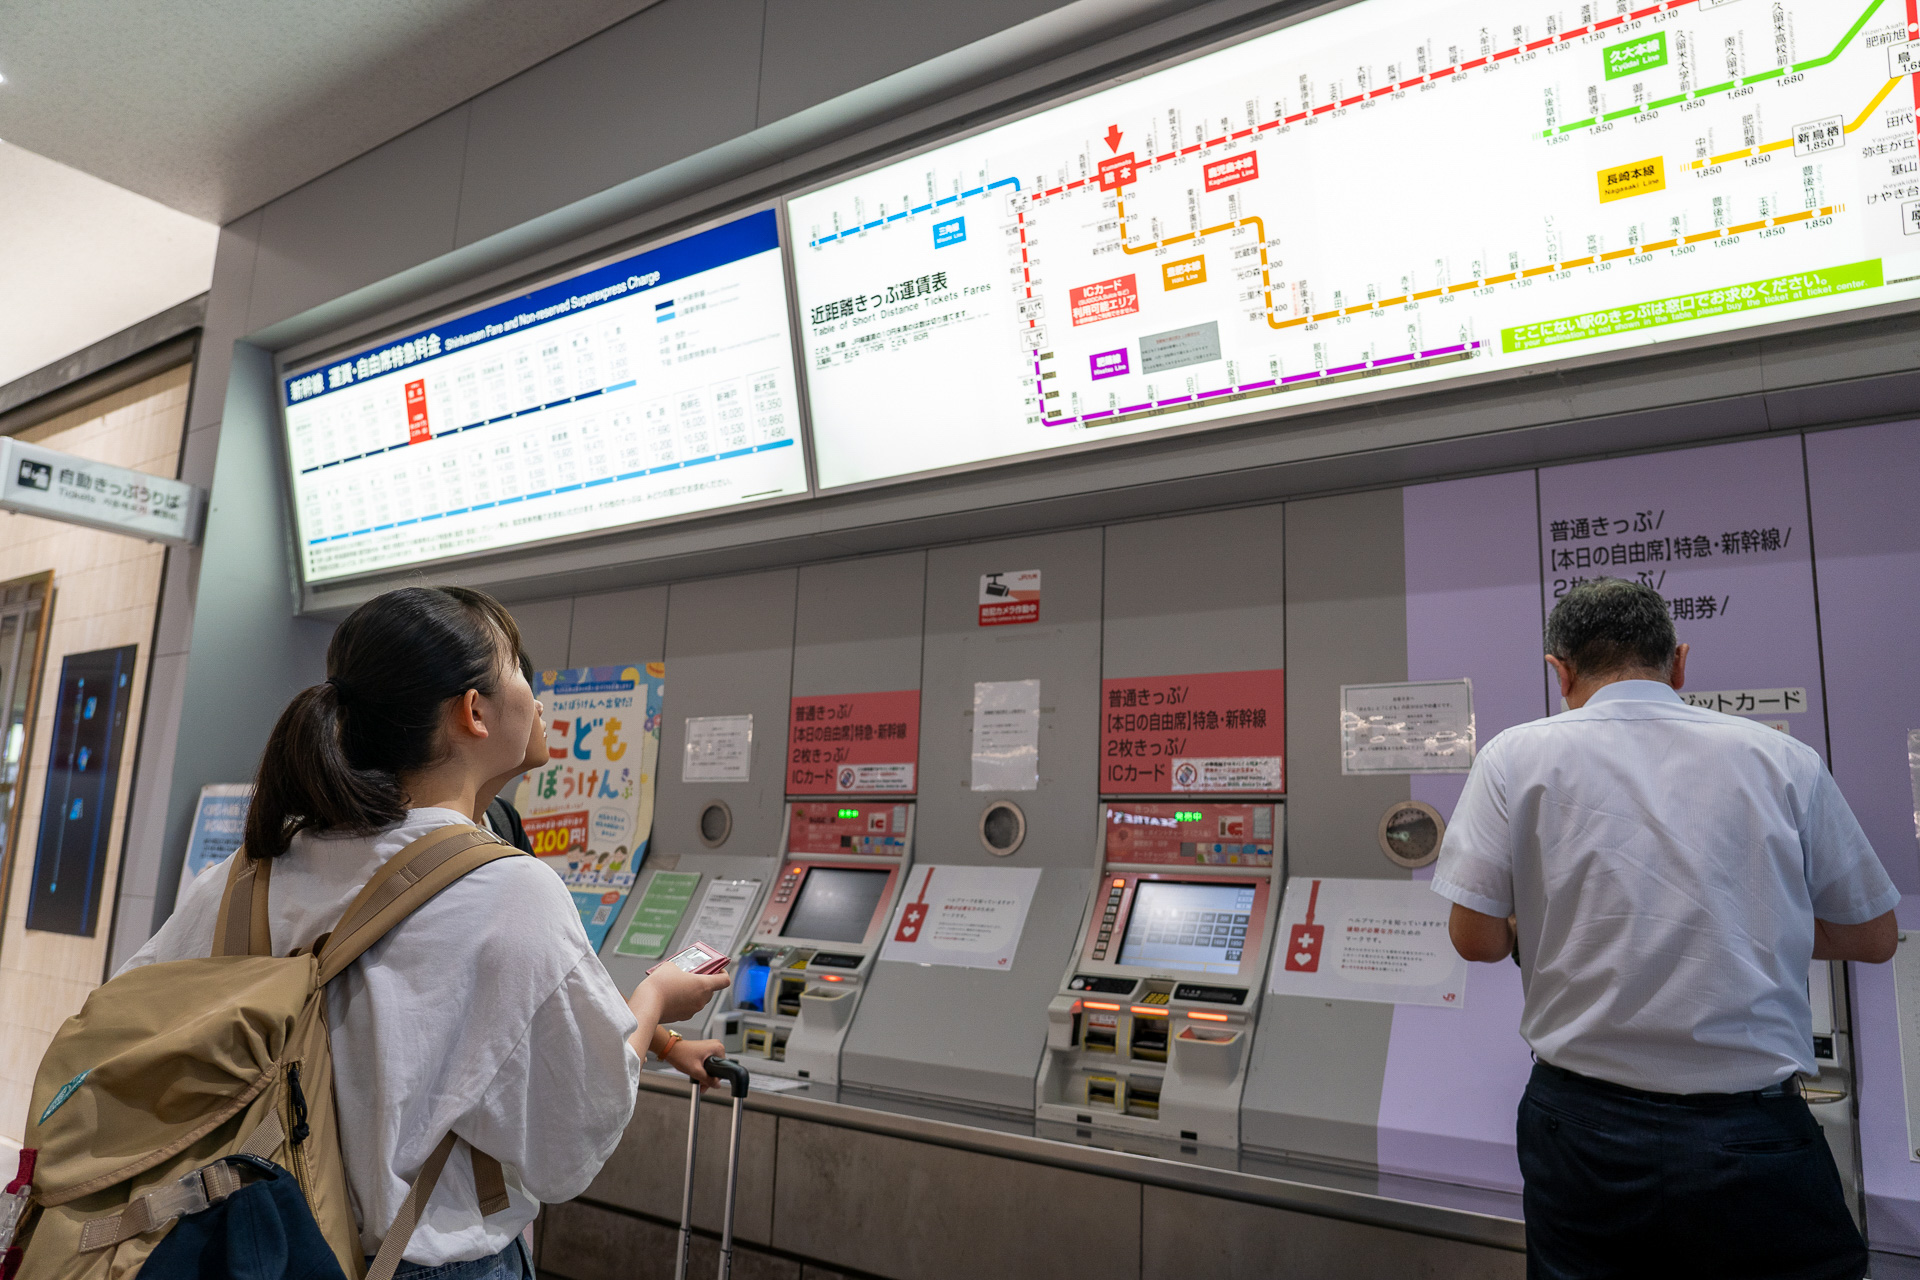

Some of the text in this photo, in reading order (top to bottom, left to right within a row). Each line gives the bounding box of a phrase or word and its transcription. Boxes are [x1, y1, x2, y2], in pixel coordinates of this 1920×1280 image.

[1653, 9, 1678, 24] 1,310
[1617, 20, 1642, 35] 1,310
[1581, 31, 1606, 45] 1,130
[1865, 28, 1907, 49] 肥前旭
[1609, 38, 1661, 65] 久大本線
[1642, 54, 1660, 65] Line
[1776, 73, 1804, 88] 1,680
[1727, 86, 1754, 100] 1,680
[1680, 98, 1706, 112] 1,850
[1634, 110, 1660, 124] 1,850
[1887, 113, 1914, 129] 田代
[1589, 122, 1615, 136] 1,850
[1798, 125, 1840, 144] 新鳥栖
[1806, 138, 1835, 152] 1,850
[1862, 136, 1916, 159] 弥生が丘
[1744, 154, 1771, 168] 1,850
[1891, 161, 1918, 176] 基山
[1607, 164, 1656, 186] 長崎本線
[1696, 165, 1723, 179] 1,850
[1604, 177, 1660, 196] Nagasaki Line
[1867, 186, 1919, 205] けやき台
[1805, 216, 1833, 230] 1,850
[1758, 226, 1786, 240] 1,850
[1713, 235, 1740, 249] 1,680
[1670, 244, 1696, 258] 1,500
[1269, 260, 1284, 270] 300
[1628, 253, 1654, 266] 1,500
[1587, 261, 1612, 275] 1,130
[1510, 278, 1533, 290] 1,130
[1548, 270, 1572, 283] 1,130
[1082, 279, 1122, 298] ICカード
[1271, 281, 1286, 292] 380
[1472, 286, 1495, 298] 1,130
[503, 315, 519, 331] and
[570, 279, 628, 310] Superexpress
[627, 270, 660, 290] Charge
[811, 271, 948, 325] 近距離きっぷ運賃表
[1438, 294, 1455, 305] 950
[813, 283, 991, 337] Table of Short Distance Tickets Fares
[1273, 303, 1288, 313] 400
[1369, 309, 1385, 319] 760
[1403, 302, 1419, 312] 860
[1514, 273, 1827, 341] ここにない駅のきっぷは窓口でお求めください。
[1544, 330, 1586, 344] destination
[1598, 326, 1612, 334] not
[1615, 320, 1640, 332] shown
[1644, 318, 1652, 326] in
[1655, 314, 1668, 324] the
[1696, 305, 1723, 318] please
[1726, 301, 1743, 312] buy
[1746, 298, 1760, 307] the
[1764, 293, 1789, 304] ticket
[1792, 291, 1803, 299] at
[1806, 285, 1832, 296] ticket
[1304, 322, 1319, 332] 480
[1336, 316, 1352, 326] 570
[58, 467, 180, 510] 自動きっぷうりば
[1550, 509, 1665, 543] 普通きっぷ/
[1551, 526, 1792, 574] 【本日の自由席】特急・新幹線/
[1553, 569, 1666, 598] 2枚ぷ/
[1108, 686, 1189, 709] 普通きっぷ/
[795, 703, 854, 722] 普通きっぷ/
[1107, 708, 1267, 733] 【本日の自由席】特急・新幹線
[548, 716, 628, 762] こども
[792, 747, 850, 764] 2枚きっぷ/
[1107, 738, 1187, 758] 2枚きっぷ/
[792, 769, 834, 785] ICカード
[1107, 764, 1166, 782] ICカード
[537, 764, 619, 800] ぼうけん
